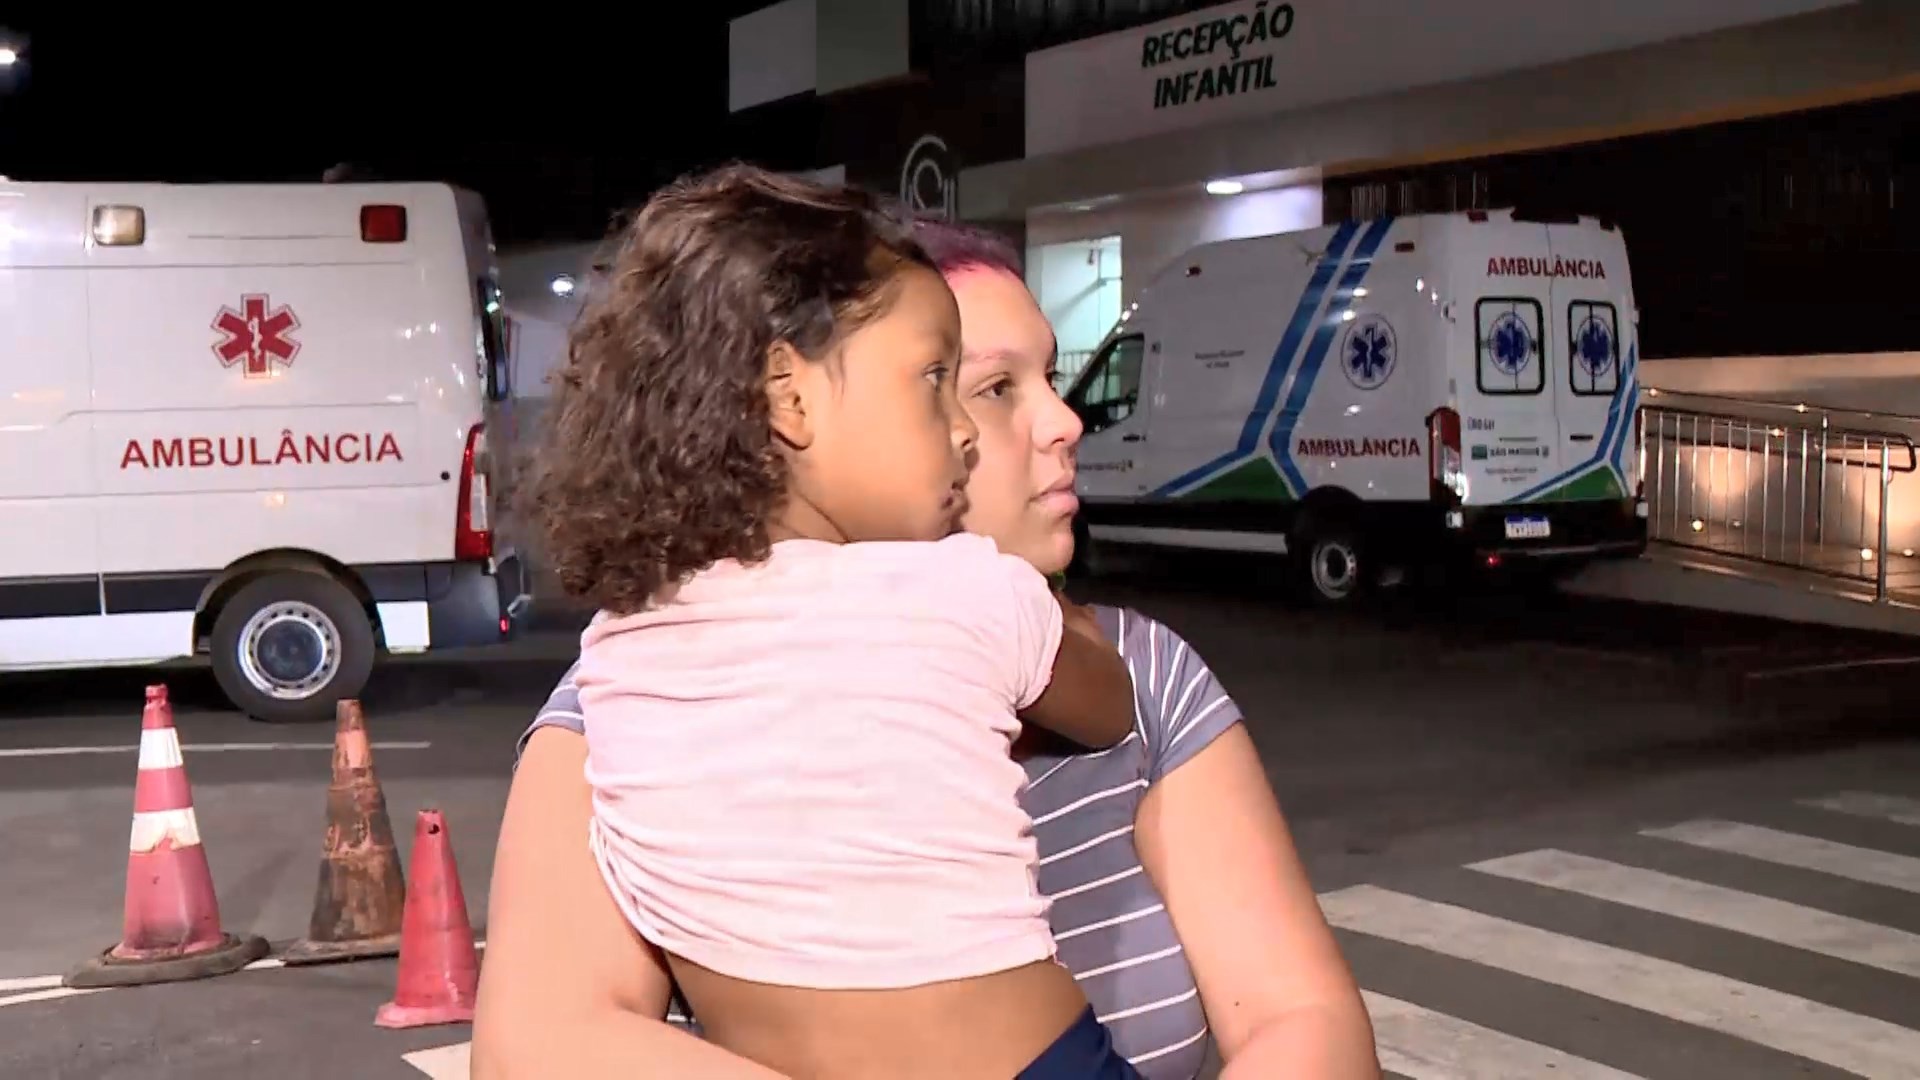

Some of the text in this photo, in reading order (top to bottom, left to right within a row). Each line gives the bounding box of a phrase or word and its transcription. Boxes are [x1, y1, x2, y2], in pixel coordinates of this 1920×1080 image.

[1142, 1, 1294, 68] RECEPÇÃO
[1154, 54, 1277, 109] INFANTIL
[1486, 254, 1606, 280] AMBULÂNCIA
[119, 428, 404, 470] AMBULÂNCIA
